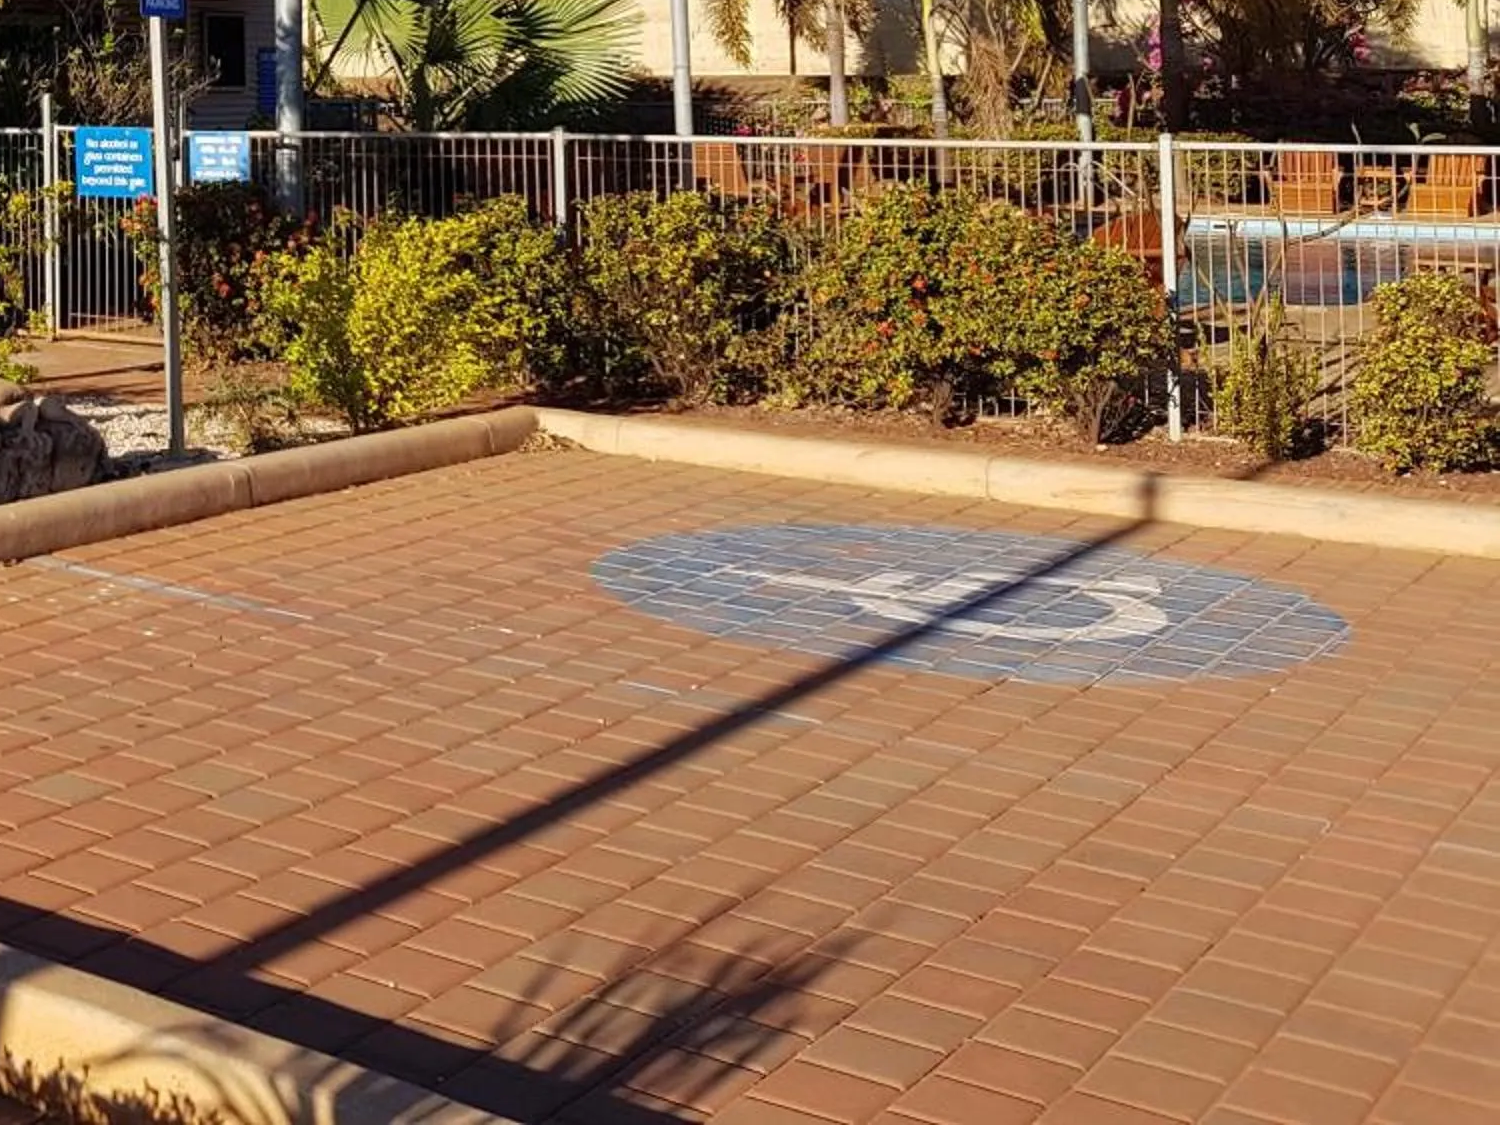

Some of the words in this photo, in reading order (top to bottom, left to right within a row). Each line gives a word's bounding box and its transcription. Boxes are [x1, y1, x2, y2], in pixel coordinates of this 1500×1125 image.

[99, 139, 129, 149] alcohol
[83, 152, 102, 165] glass
[93, 164, 133, 175] permitted
[81, 175, 112, 187] beyond
